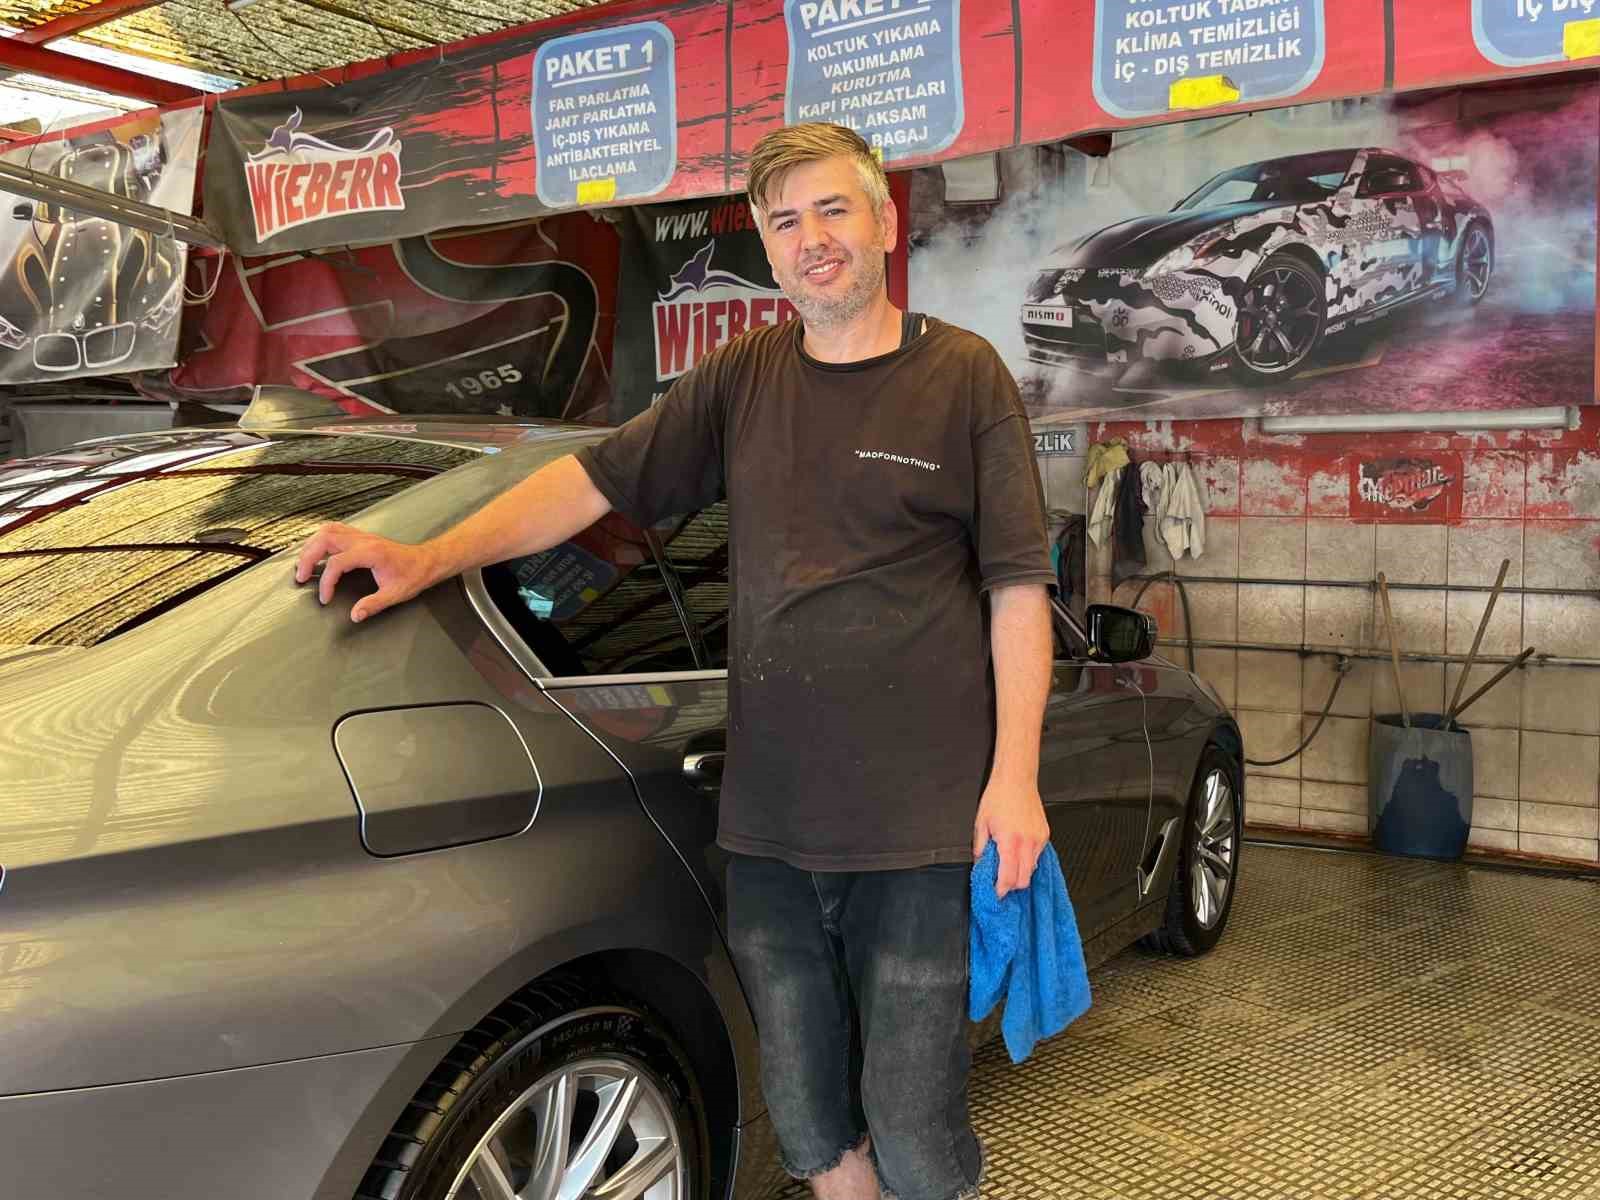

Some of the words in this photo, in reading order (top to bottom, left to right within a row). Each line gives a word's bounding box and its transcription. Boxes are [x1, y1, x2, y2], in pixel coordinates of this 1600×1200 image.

[1125, 0, 1212, 29] KOLTUK
[1217, 0, 1288, 15] TAB
[807, 35, 869, 63] KOLTUK
[872, 18, 941, 46] YIKAMA
[1115, 31, 1182, 55] KLİMA
[1189, 6, 1300, 45] TEMİZLİĞİ
[545, 43, 631, 82] PAKET
[641, 39, 653, 63] 1
[822, 44, 925, 79] VAKUMLAMA
[1114, 59, 1135, 82] İÇ
[1155, 55, 1190, 76] DIŞ
[1196, 37, 1302, 70] TEMİZLİK
[831, 67, 912, 94] KURUTMA
[549, 97, 575, 113] FAR
[578, 83, 651, 108] PARLATMA
[799, 100, 836, 119] KAPI
[841, 80, 946, 111] PANZATLARI
[545, 114, 579, 131] JANT
[583, 101, 657, 124] PARLATMA
[594, 120, 650, 140] YIKAMA
[865, 104, 927, 128] AKSAM
[871, 126, 928, 147] BAGAJ
[546, 138, 662, 168] ANTİBAKTERİYEL
[445, 363, 523, 399] 1965
